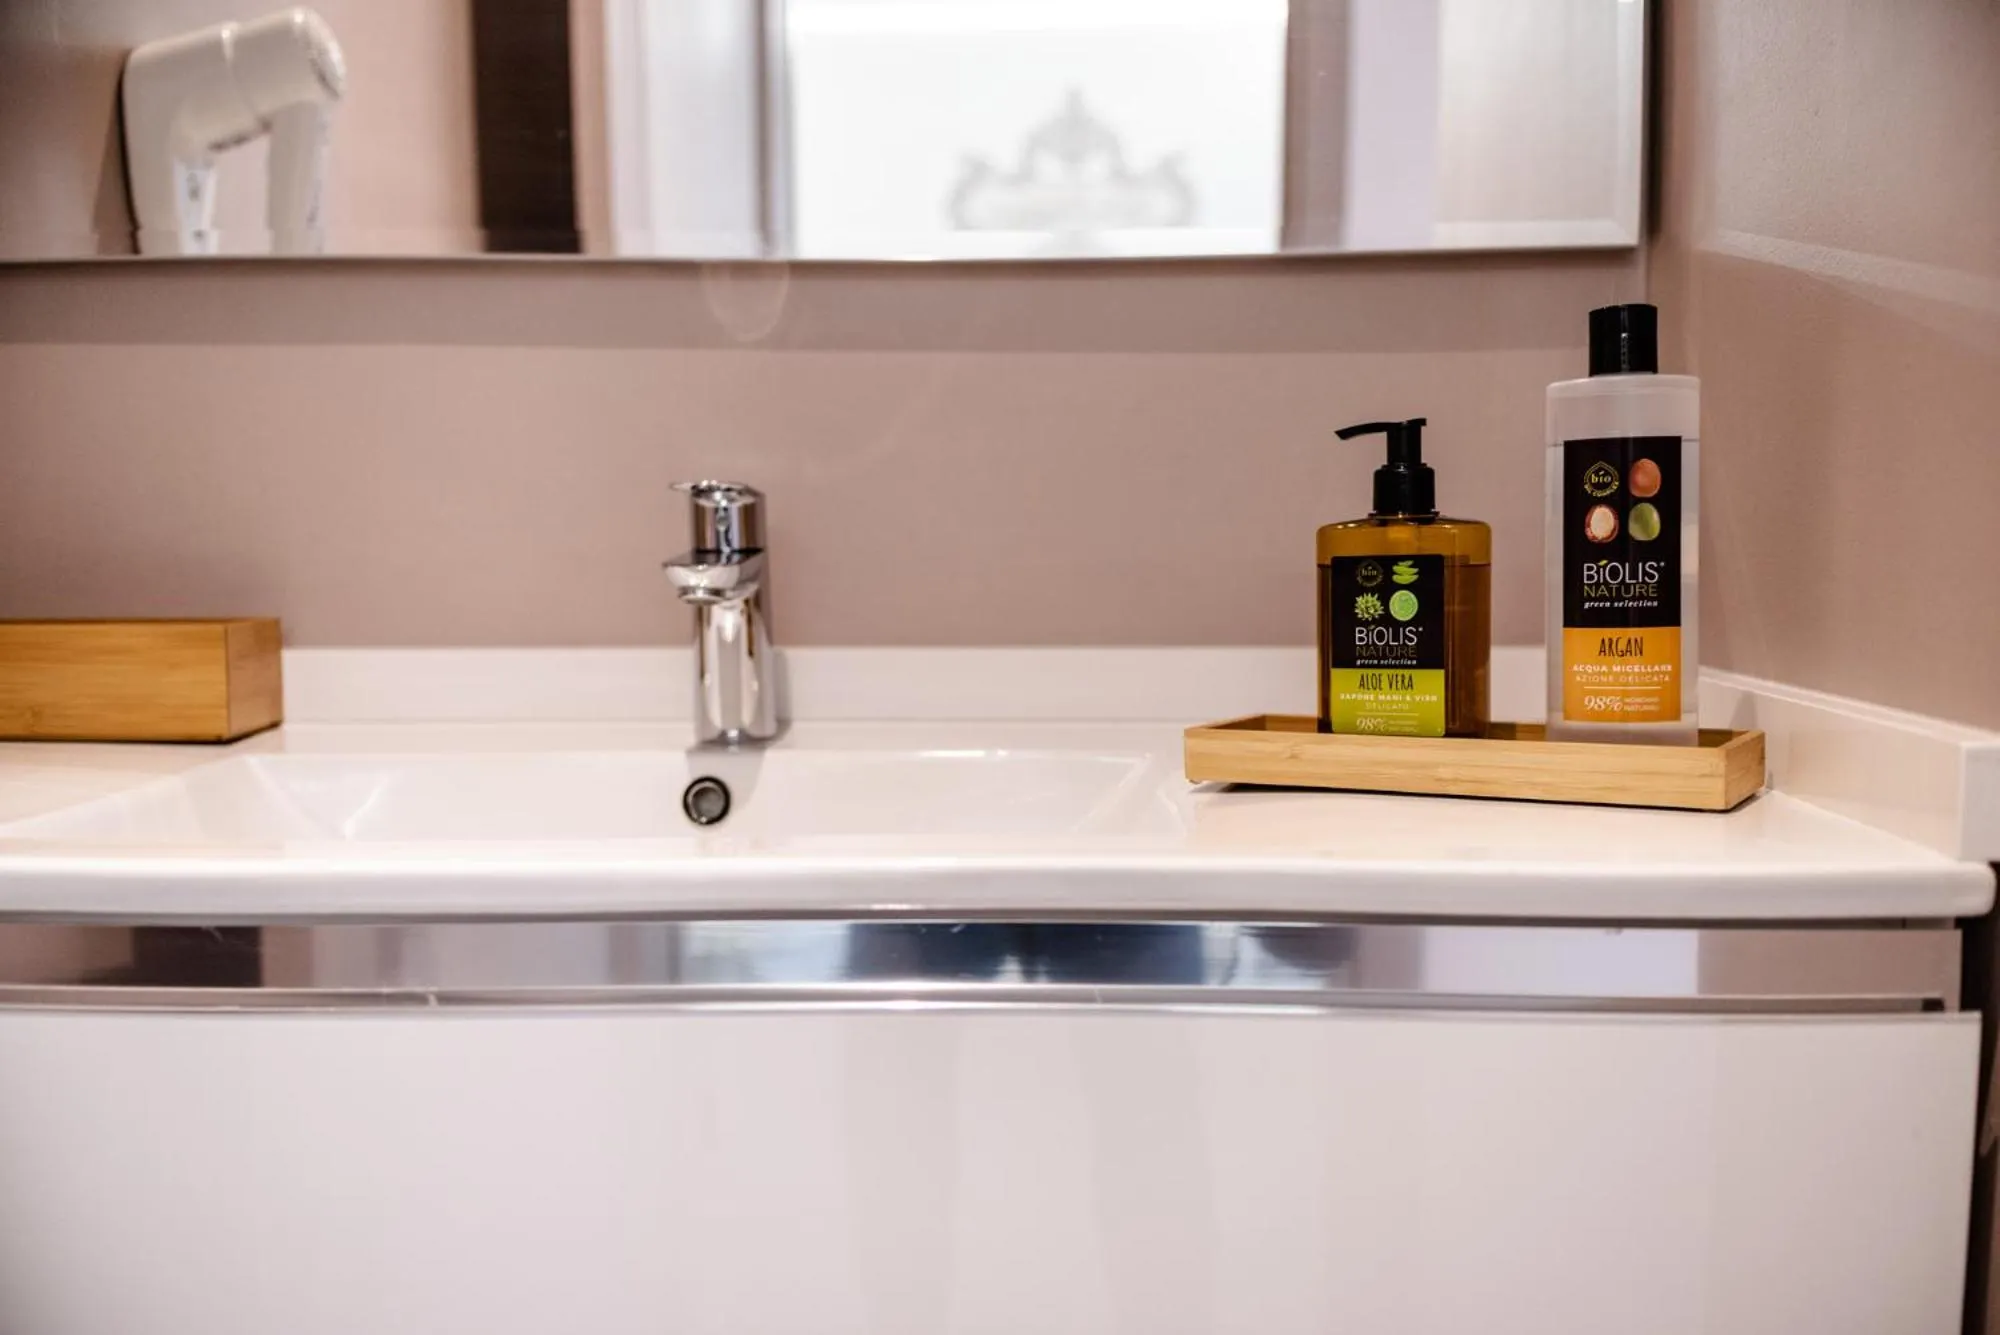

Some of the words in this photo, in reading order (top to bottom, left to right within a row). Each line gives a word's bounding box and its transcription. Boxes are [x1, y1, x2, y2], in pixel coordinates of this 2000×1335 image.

[1591, 471, 1611, 484] bio
[1583, 584, 1658, 597] NATURE
[1583, 601, 1610, 609] green
[1614, 600, 1658, 608] selection
[1356, 646, 1417, 658] NATURE
[1598, 637, 1643, 657] ARGAN
[1356, 659, 1378, 667] green
[1380, 658, 1417, 666] selection
[1573, 664, 1608, 673] ACQUA
[1612, 664, 1672, 673] MICELLARE
[1359, 673, 1383, 690] ALOE
[1387, 673, 1414, 691] VERA
[1576, 674, 1615, 682] AZIONE
[1340, 692, 1375, 701] SAPONE
[1378, 693, 1402, 702] MANI
[1584, 695, 1623, 712] 98%
